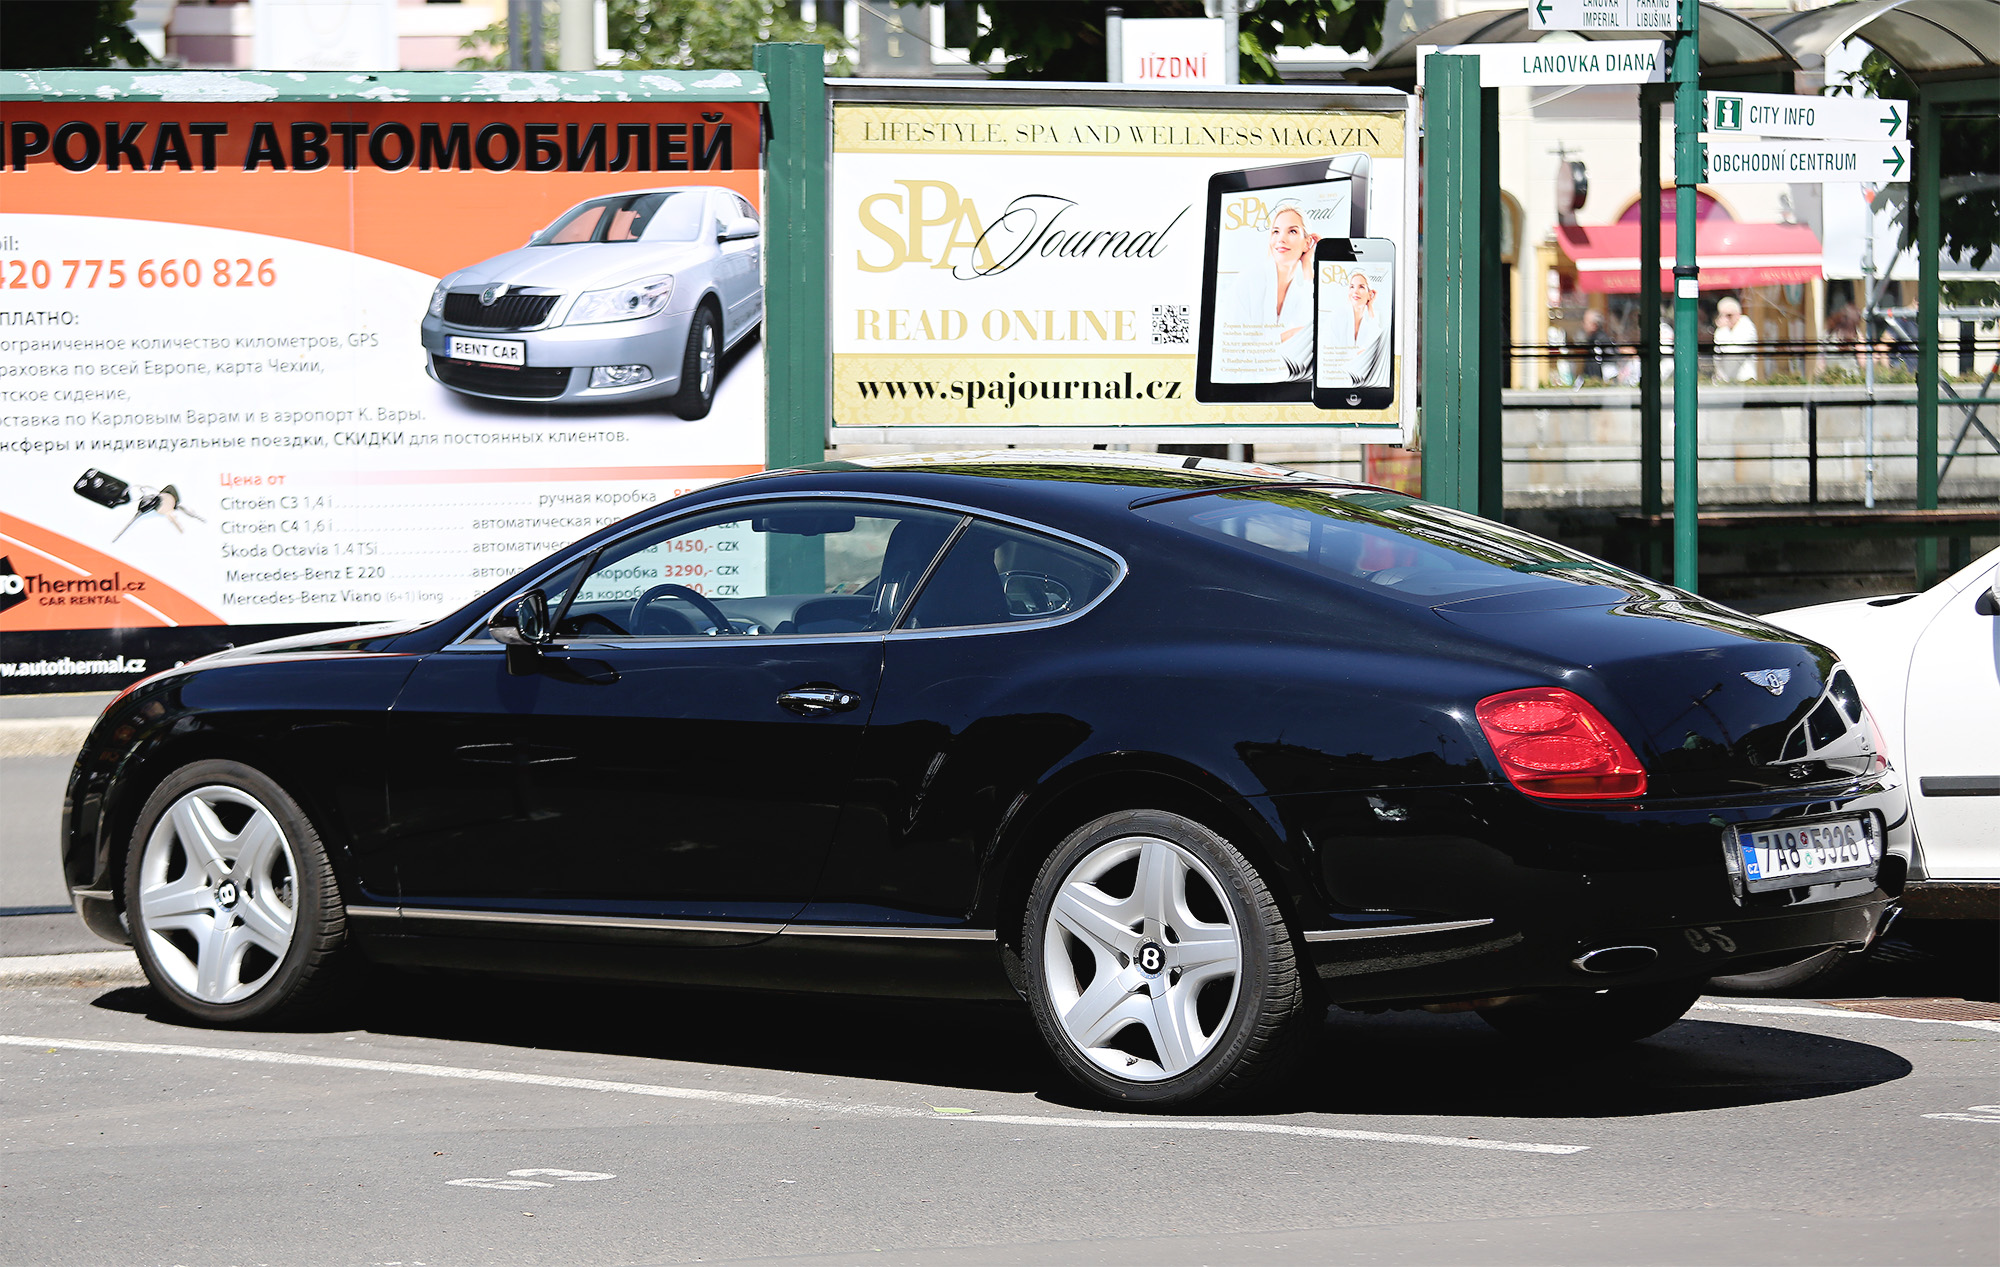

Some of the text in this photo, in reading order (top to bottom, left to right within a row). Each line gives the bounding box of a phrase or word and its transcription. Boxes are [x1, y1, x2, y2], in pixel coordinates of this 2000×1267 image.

[1583, 12, 1620, 27] IMPERIAL
[1636, 10, 1672, 27] LIBUŠINA
[1139, 52, 1208, 79] JÍZDNÍ
[1523, 53, 1656, 73] LANOVKA DIANA
[1749, 105, 1815, 126] CITY INFO
[242, 112, 734, 173] АВТОМОБИЛЕЙ
[863, 121, 1382, 147] LIFESTYLE, SPA AND WELLNESS MAGAZIN
[1713, 148, 1857, 172] OBCHODNÍ CENTRUM
[1225, 196, 1272, 231] SPA
[857, 180, 1193, 281] SPA Journal
[62, 258, 127, 290] 775
[137, 257, 202, 289] 660
[212, 257, 278, 288] 826
[854, 308, 1137, 342] READ ONLINE
[131, 337, 231, 351] количество
[235, 335, 344, 351] километров,
[347, 333, 379, 348] GPS
[455, 342, 490, 356] RENT
[492, 346, 519, 359] CAR
[74, 365, 96, 376] по
[100, 361, 139, 376] всей
[144, 360, 212, 378] Европе,
[215, 362, 263, 376] карта
[268, 358, 325, 375] Чехии,
[53, 388, 131, 403] сидение,
[856, 371, 1182, 409] www.spajournal.cz
[0, 406, 426, 429] ставка по Карловым Варам и в аэропорт К. Вары.
[75, 440, 86, 451] и
[91, 436, 247, 453] индивидуальные
[251, 433, 329, 449] поездки,
[333, 431, 405, 448] СКИДКИ
[408, 432, 439, 446] для
[443, 431, 544, 446] постоянных
[548, 429, 630, 444] клиентов.
[219, 472, 287, 489] Цена от
[220, 496, 276, 511] Citroën
[280, 496, 299, 510] C3
[303, 496, 325, 511] 1,4
[538, 491, 593, 507] ручная
[595, 489, 657, 505] коробка
[220, 520, 276, 534] Citroën
[280, 520, 300, 533] C4
[303, 519, 325, 534] 1,6
[472, 516, 592, 530] автоматическая
[272, 543, 329, 557] Octavia
[716, 541, 740, 552] CZK
[226, 566, 386, 583] Mercedes-Benz E 220
[664, 564, 713, 577] 3290,-
[716, 565, 740, 576] CZK
[222, 590, 337, 606] Mercedes-Benz
[340, 589, 382, 602] Viano
[418, 589, 444, 604] long
[716, 584, 740, 596] CZK
[39, 595, 121, 606] CAR RENTAL
[0, 654, 147, 678] w.autothermal.cz
[1758, 832, 1801, 873] 7A8
[1747, 862, 1760, 875] CZ
[1142, 947, 1160, 970] B
